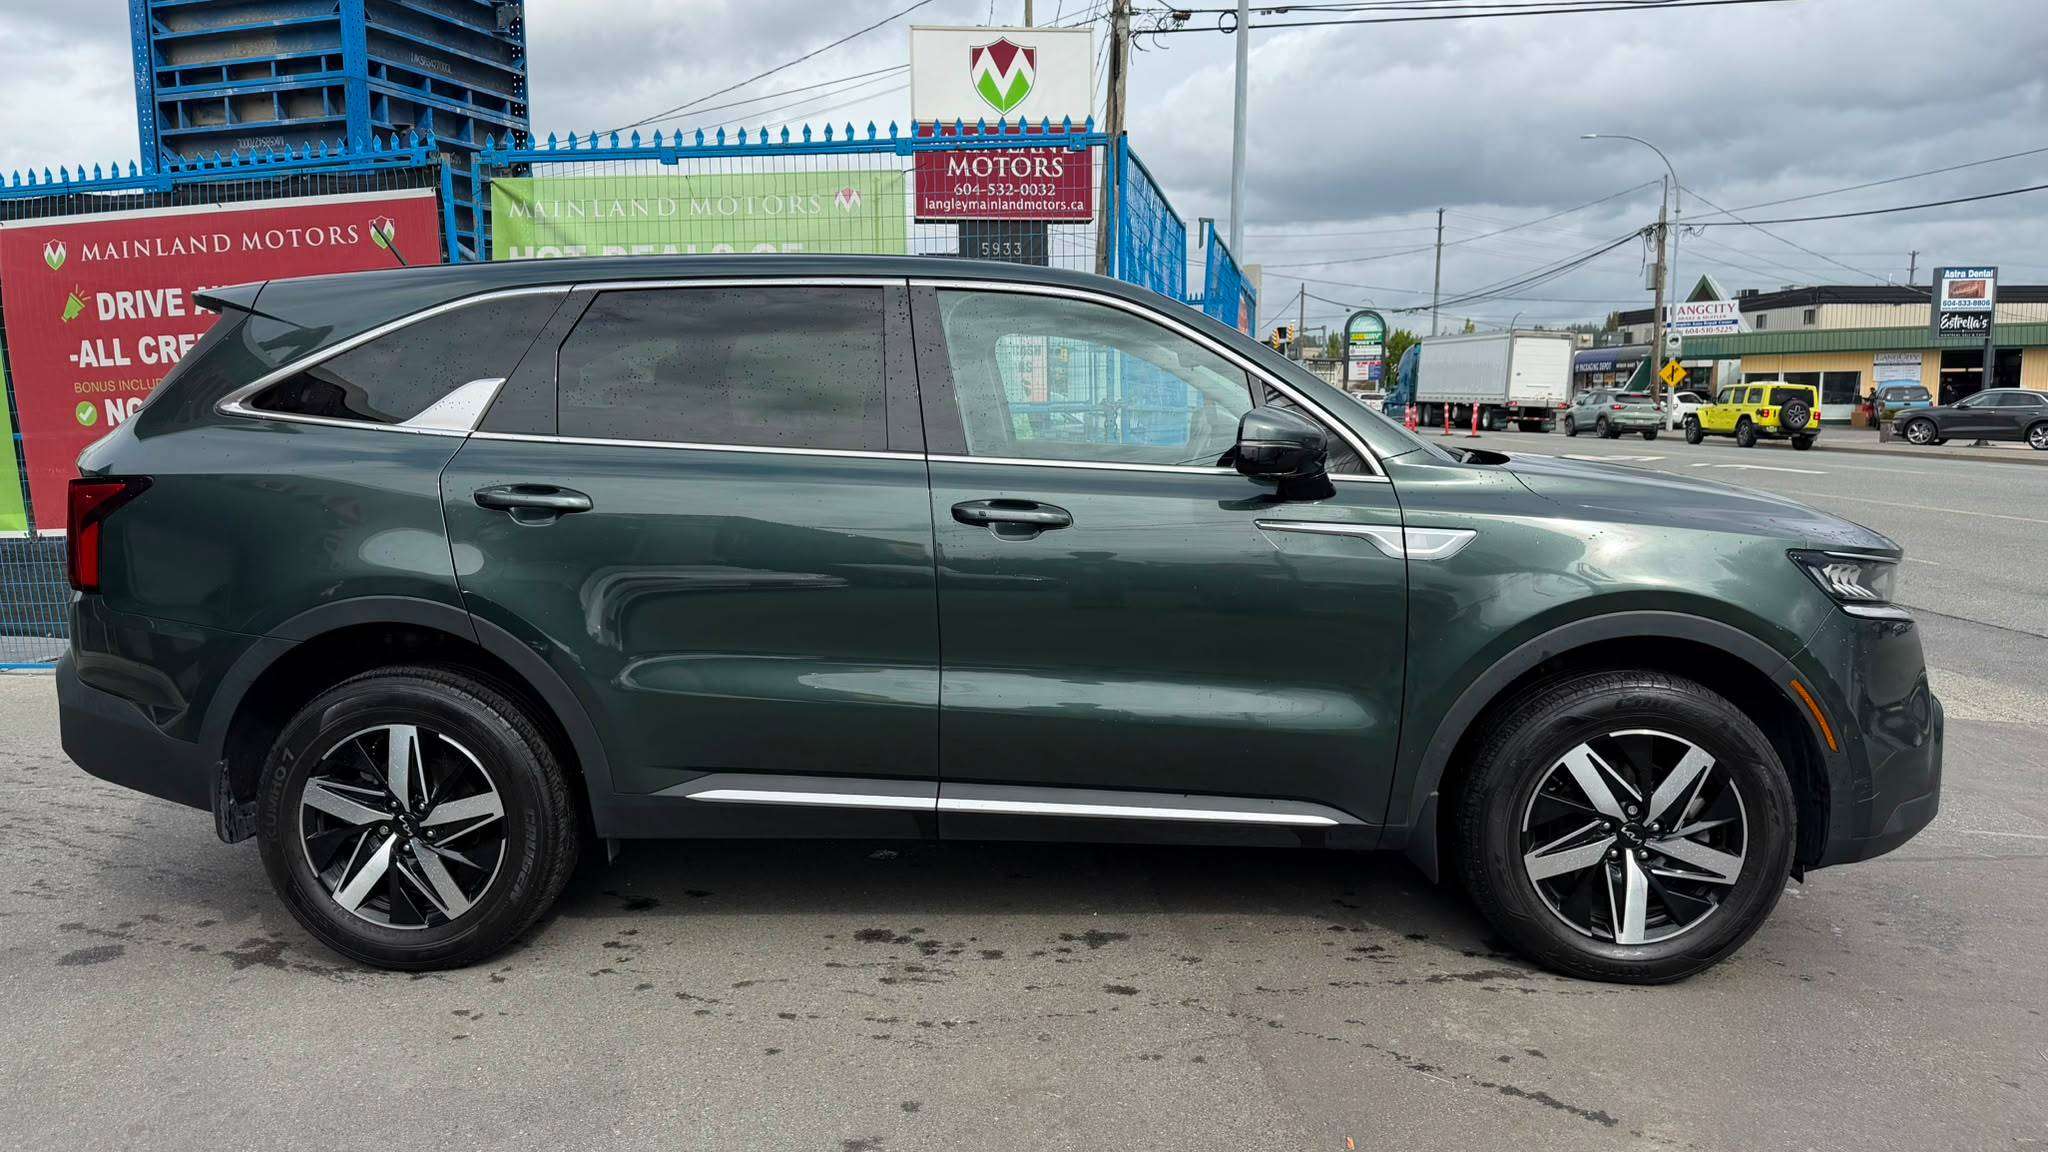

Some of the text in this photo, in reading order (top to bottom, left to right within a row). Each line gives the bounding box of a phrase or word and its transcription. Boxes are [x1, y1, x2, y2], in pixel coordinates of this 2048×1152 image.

[946, 156, 1064, 178] MOTORS
[953, 183, 1056, 196] 604-532-0032
[509, 197, 676, 218] MAINLAND
[689, 194, 822, 216] MOTORS
[925, 198, 1085, 213] langleymainlandmotors.ca
[81, 234, 231, 262] MAINLAND
[241, 224, 359, 251] MOTORS
[981, 242, 1022, 256] 5933
[96, 287, 186, 321] DRIVE
[1940, 312, 1988, 329] Estrella's
[69, 333, 205, 368] -ALL CRE
[74, 380, 116, 394] BONUS
